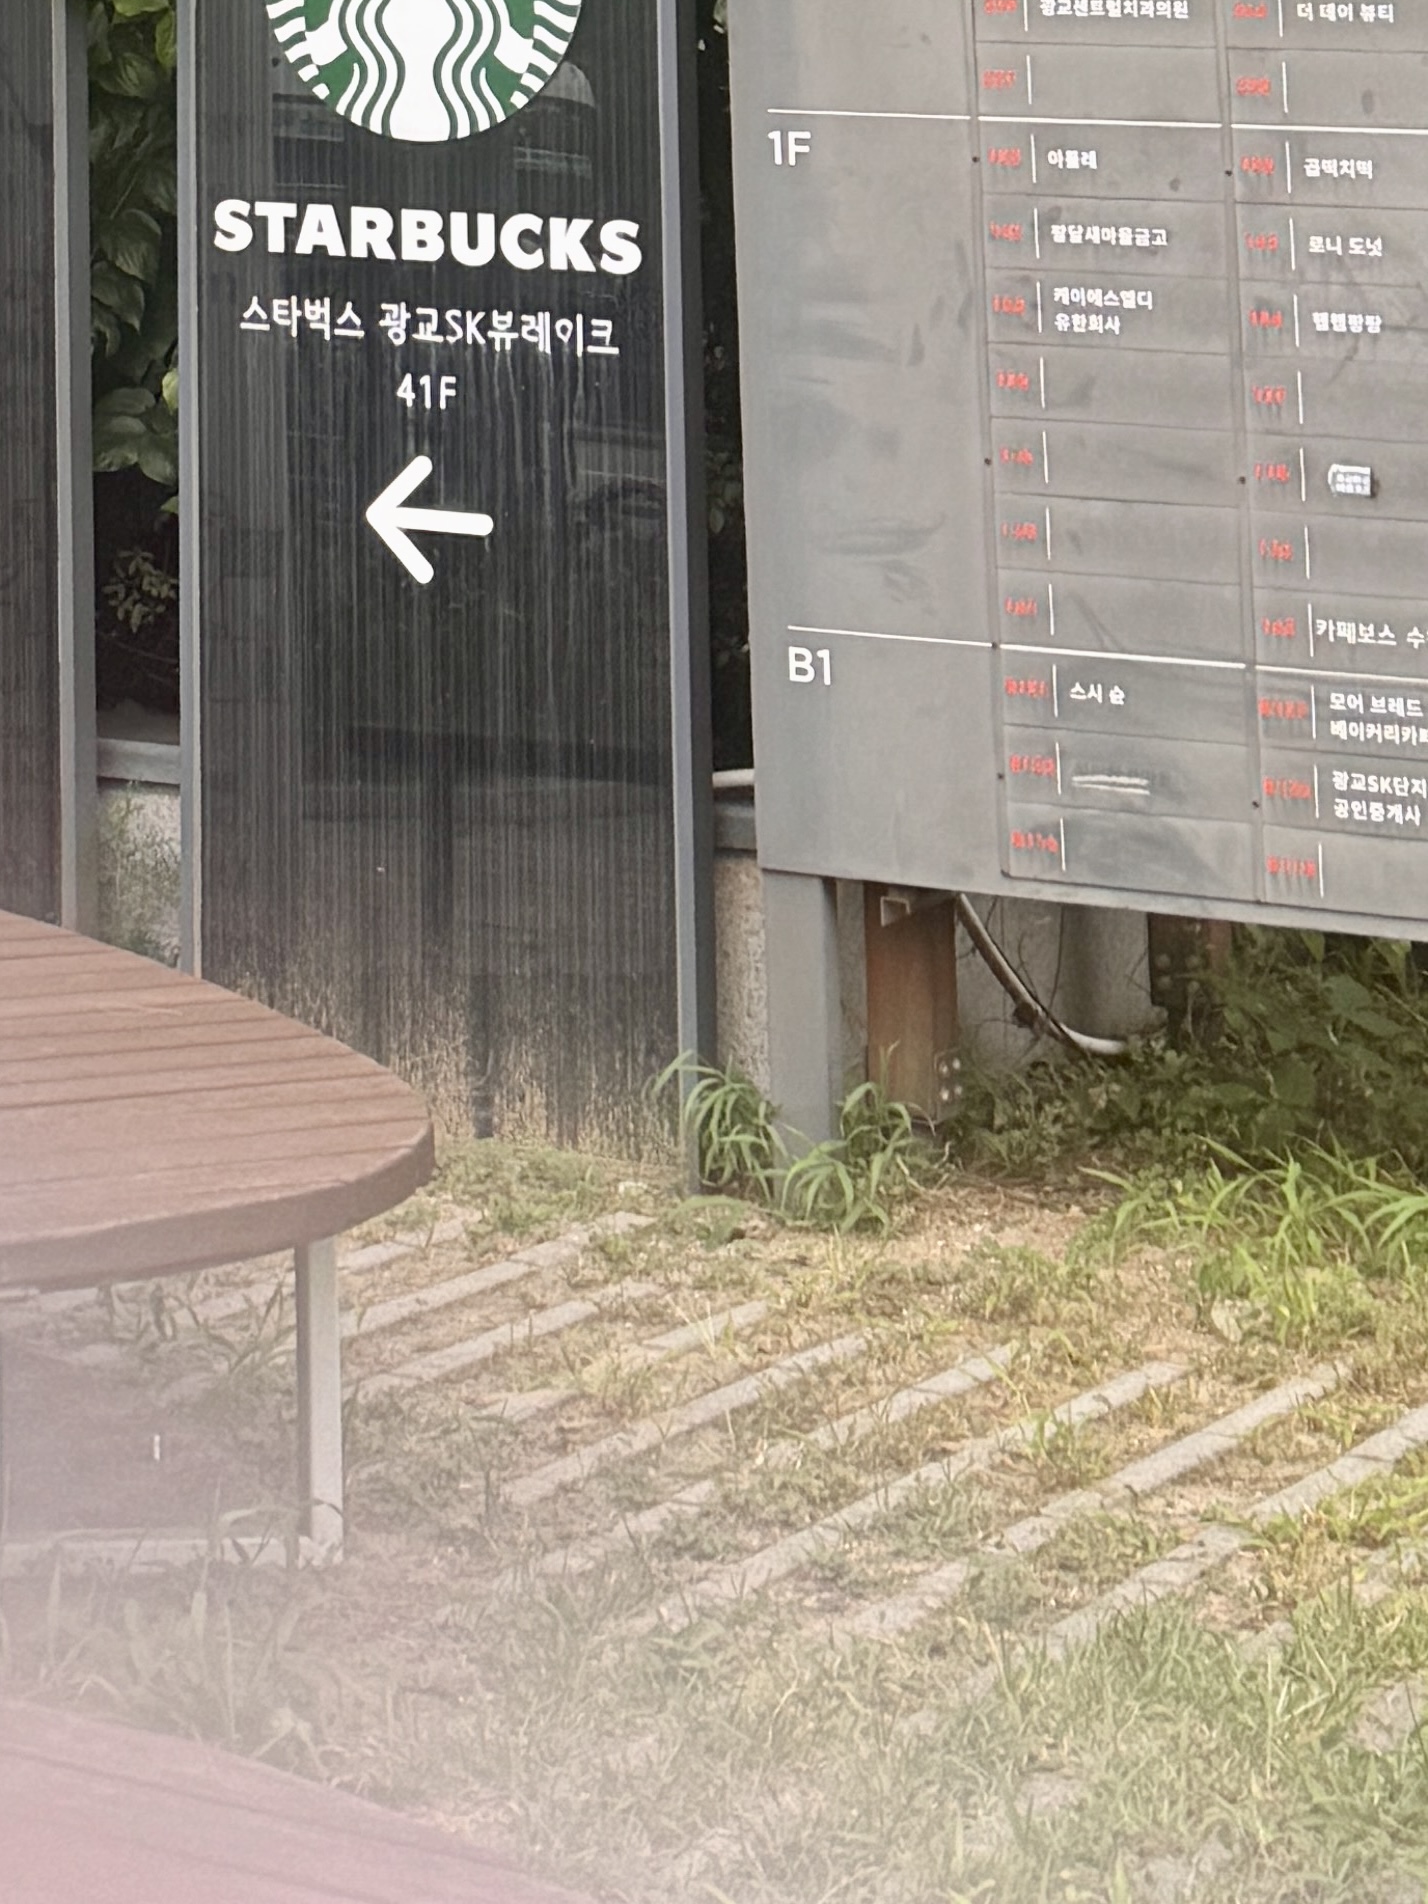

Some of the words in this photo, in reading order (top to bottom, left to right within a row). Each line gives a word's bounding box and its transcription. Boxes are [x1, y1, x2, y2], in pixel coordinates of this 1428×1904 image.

[1297, 2, 1313, 21] 더
[767, 130, 811, 166] 1F
[213, 199, 644, 276] STARBUCKS
[239, 297, 364, 343] 스타벅스
[380, 300, 619, 358] 광교SK뷰레이크
[396, 374, 457, 411] 41F
[788, 648, 832, 686] B1
[1070, 682, 1103, 704] 스시
[1330, 693, 1365, 714] 모어
[1370, 695, 1424, 718] 브레드
